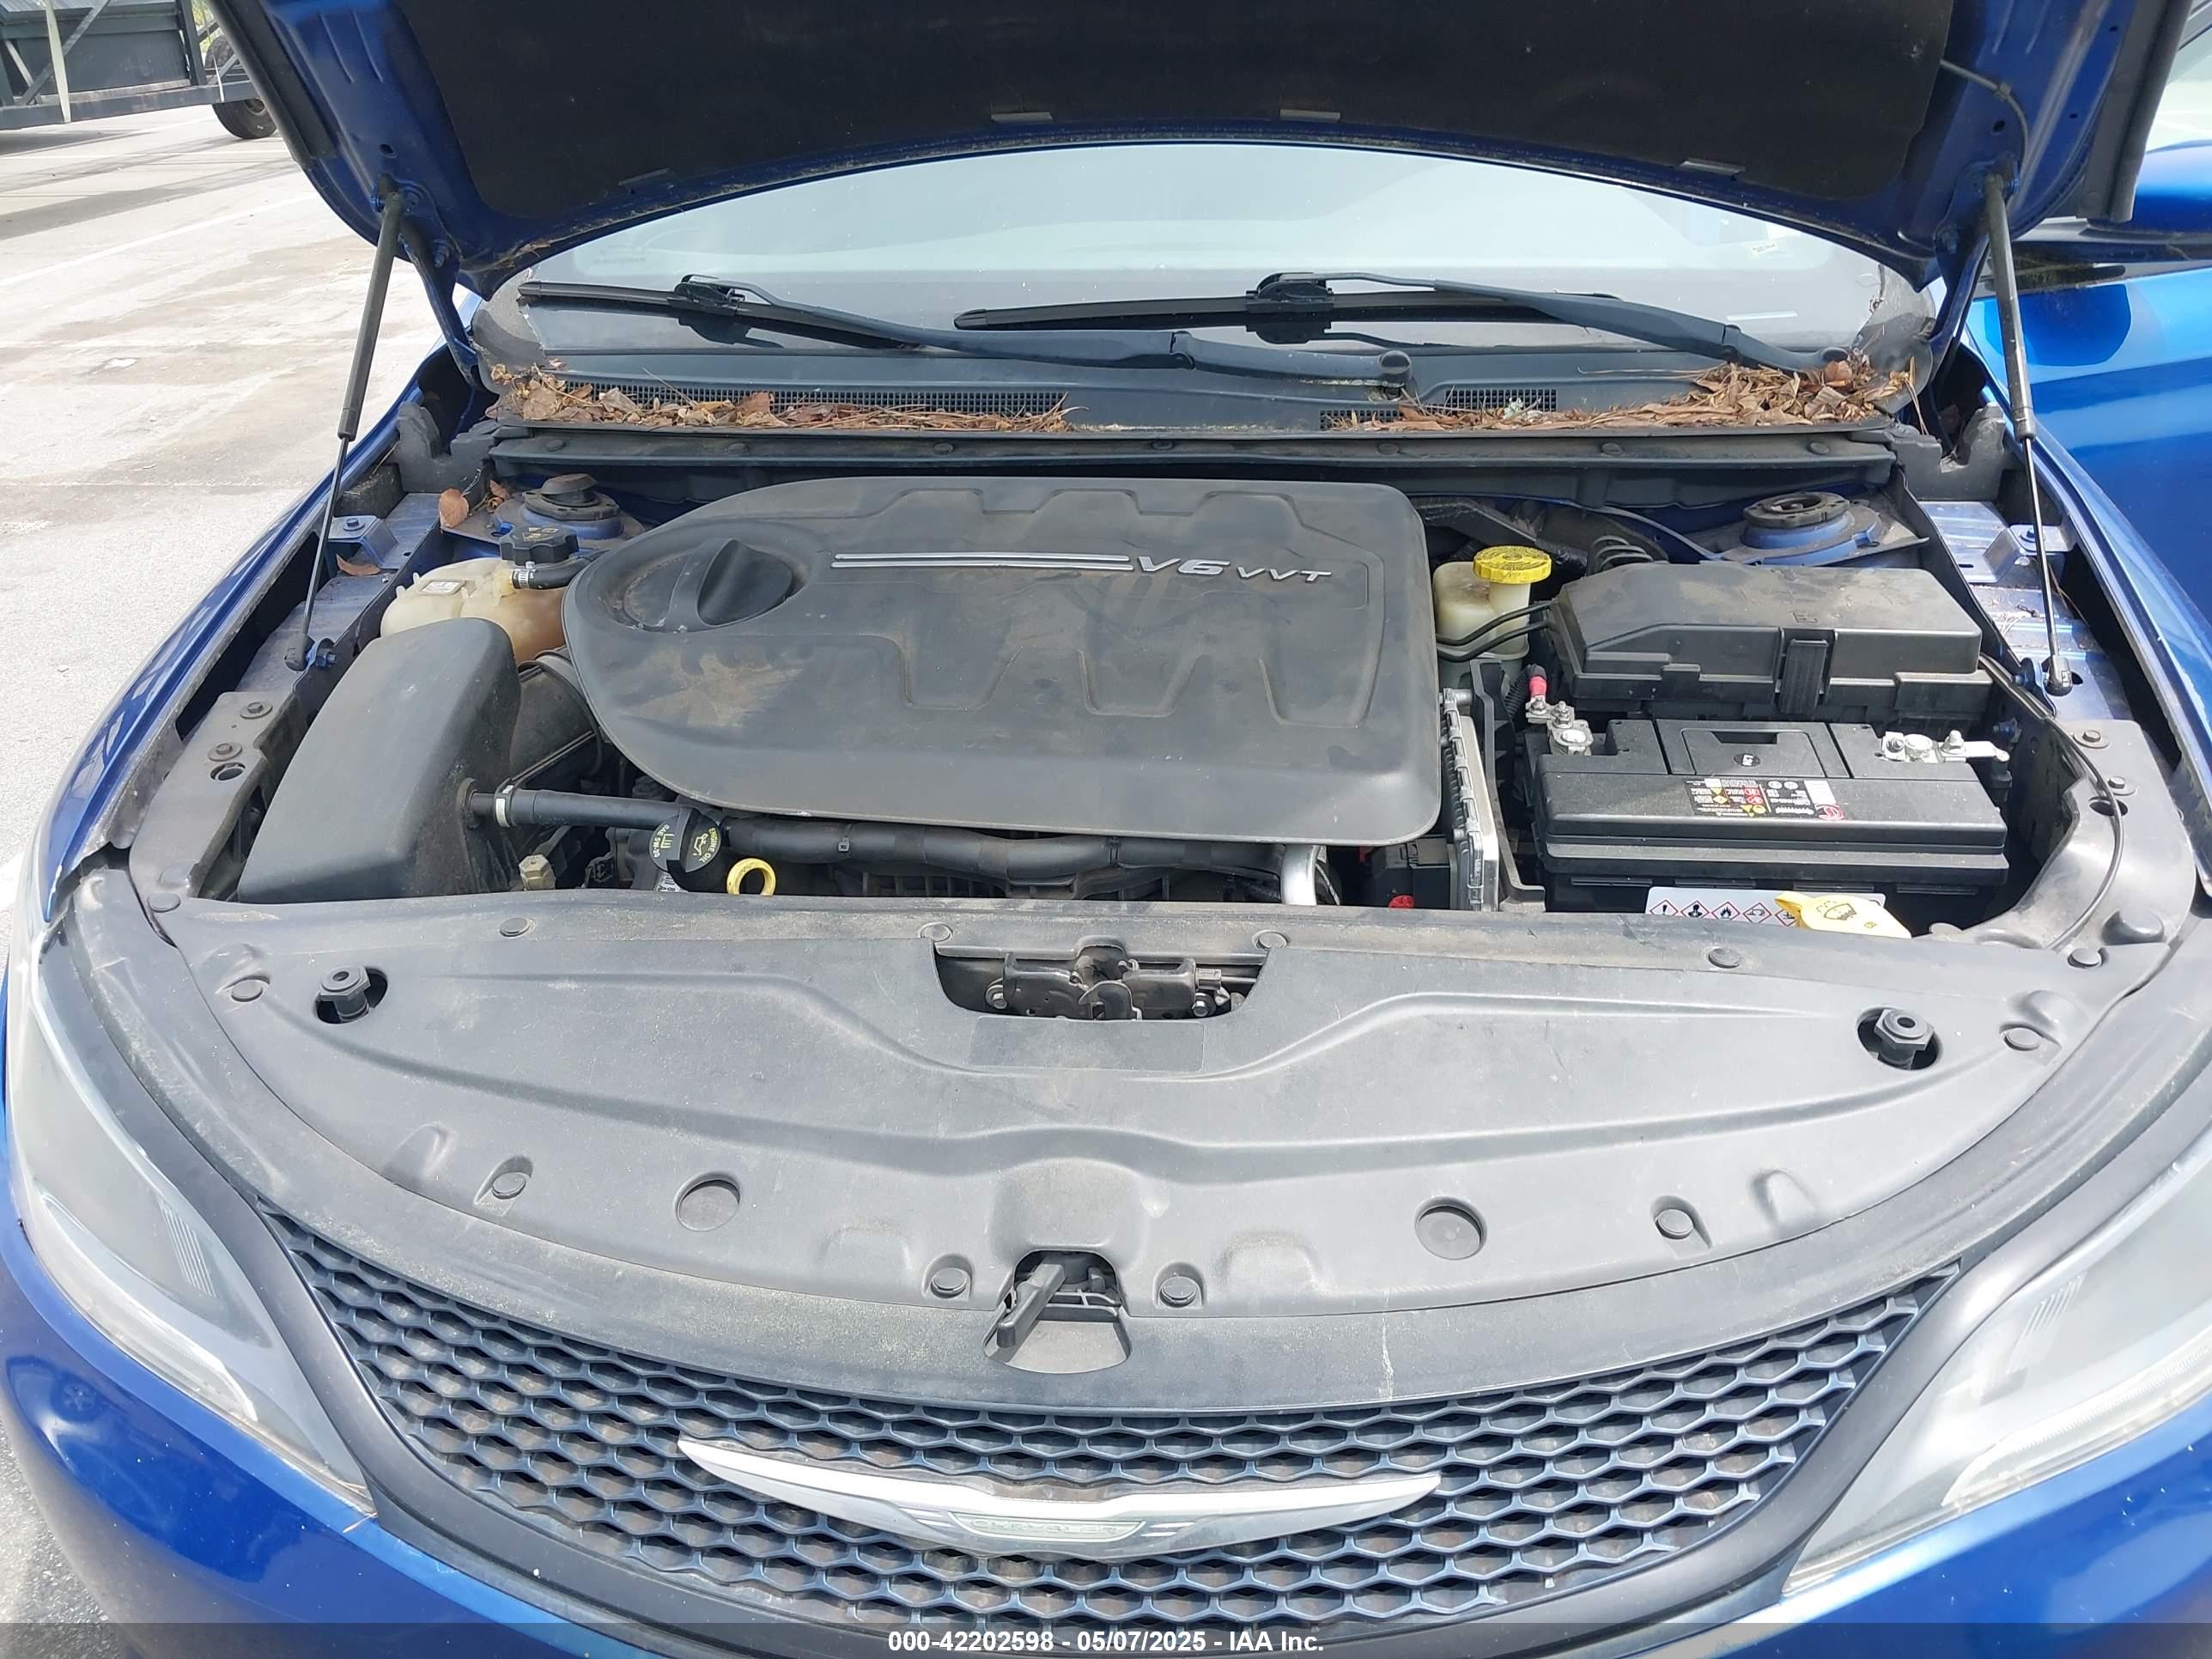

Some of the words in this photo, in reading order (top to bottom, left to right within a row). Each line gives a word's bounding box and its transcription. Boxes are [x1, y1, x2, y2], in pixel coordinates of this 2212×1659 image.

[1139, 556, 1230, 575] V6
[1237, 567, 1331, 583] VVT
[657, 824, 670, 836] SAE
[653, 837, 661, 857] 5W-20
[708, 828, 718, 853] ENGINE
[699, 853, 712, 863] OIL
[970, 1518, 1117, 1534] CHRYSLER
